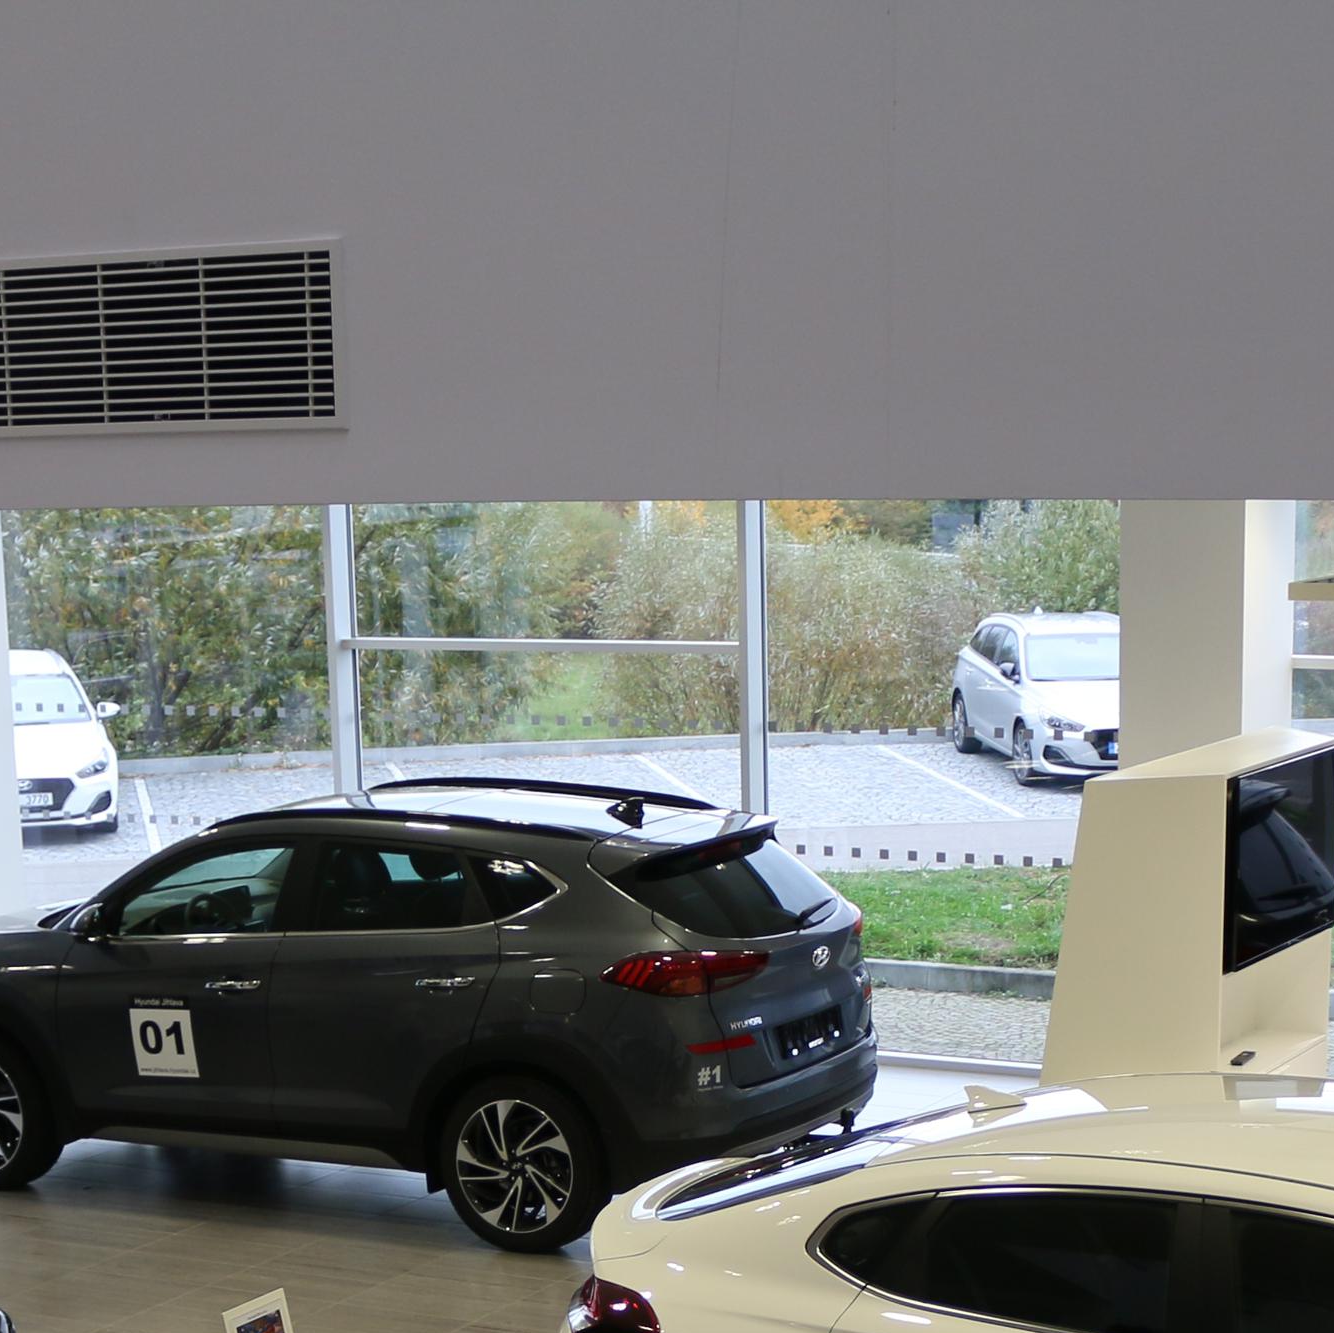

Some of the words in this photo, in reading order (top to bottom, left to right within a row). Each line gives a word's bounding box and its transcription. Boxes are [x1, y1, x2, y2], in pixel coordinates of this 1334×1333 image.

[730, 1016, 763, 1031] HYUNDAI
[139, 1020, 185, 1055] 01
[697, 1065, 722, 1086] #1
